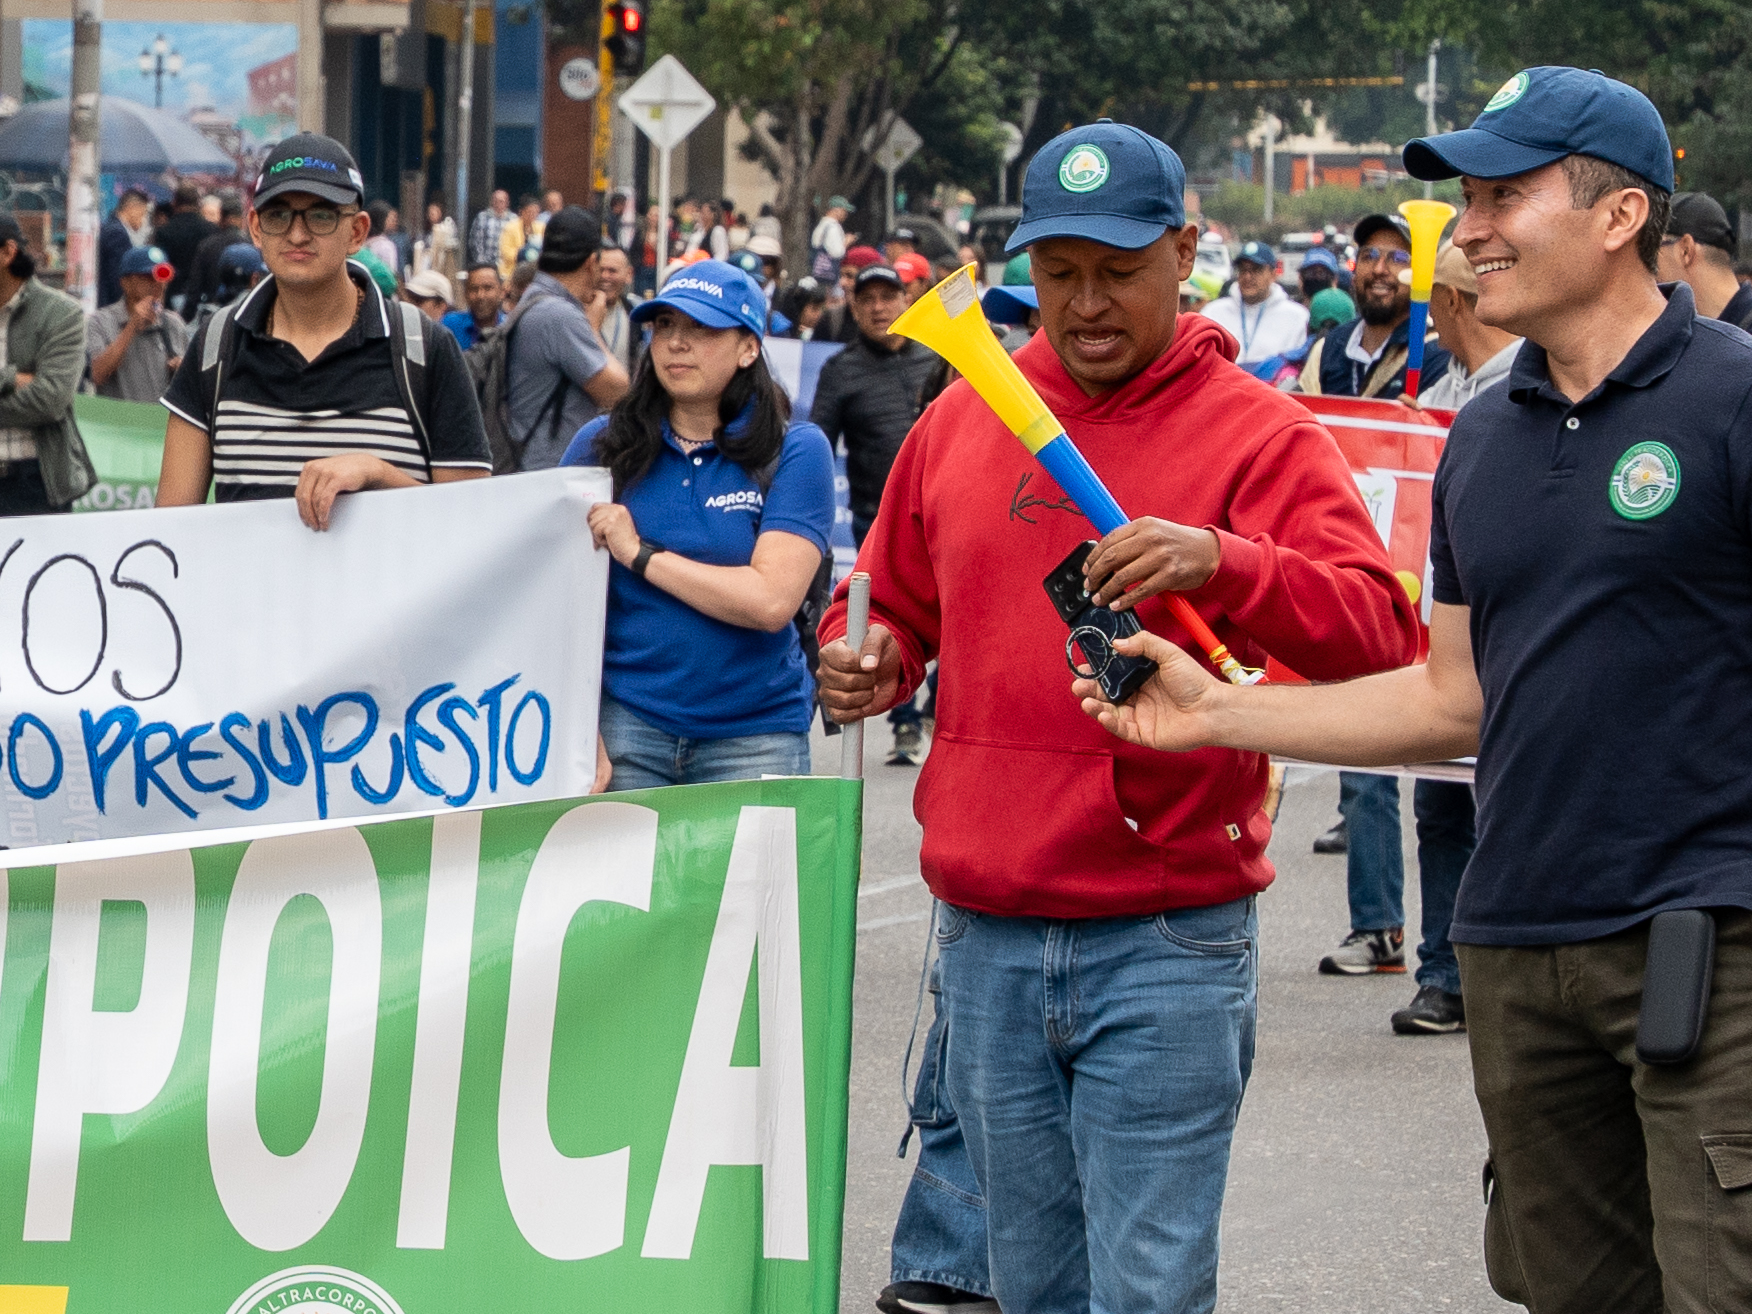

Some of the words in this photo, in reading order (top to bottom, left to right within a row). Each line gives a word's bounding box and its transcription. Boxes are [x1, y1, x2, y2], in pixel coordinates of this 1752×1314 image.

[269, 155, 338, 176] AGROSAVIA
[658, 277, 724, 300] ROSAVIA
[83, 669, 553, 822] PRESUPUESTO
